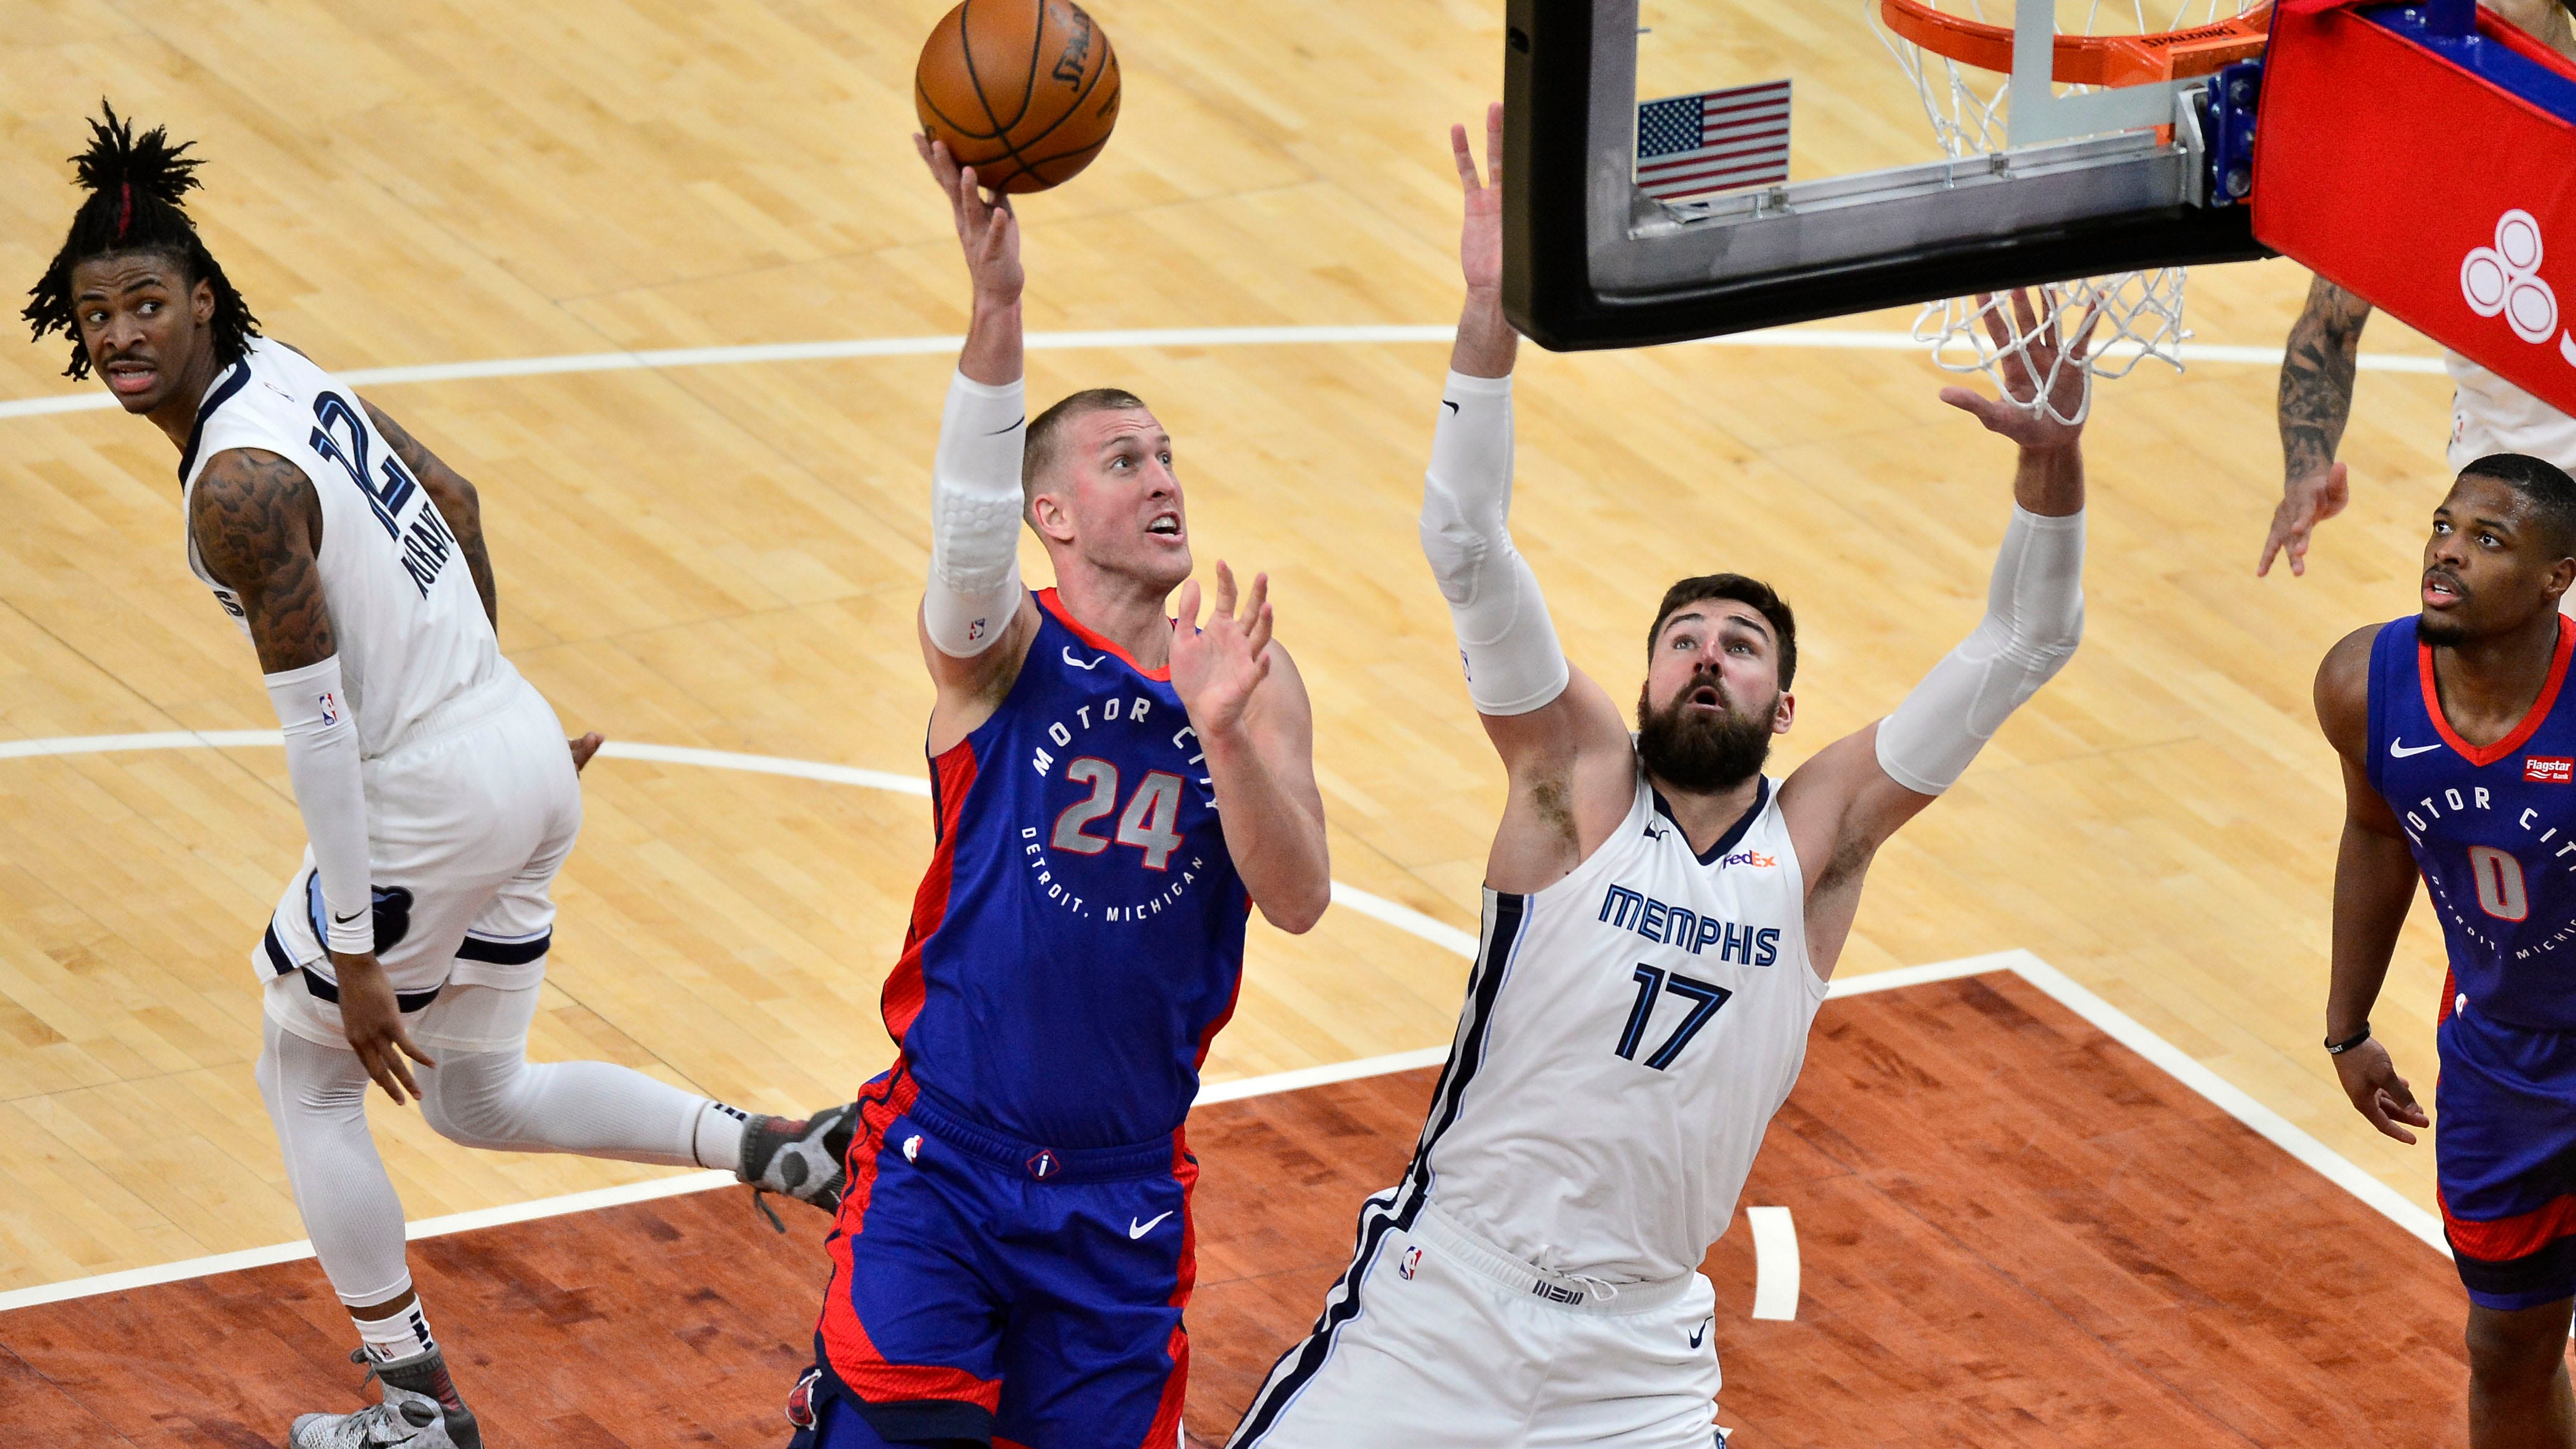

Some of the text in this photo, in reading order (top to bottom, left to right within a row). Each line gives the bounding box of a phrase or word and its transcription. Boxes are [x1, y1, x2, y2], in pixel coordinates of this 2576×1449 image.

[310, 391, 416, 543] 12
[1032, 697, 1151, 777] MOTOR
[2526, 759, 2571, 772] Flagstar
[1050, 756, 1186, 872] 24
[2519, 807, 2576, 872] CIT
[1106, 857, 1203, 922] MICHIGAN
[1723, 850, 1777, 870] FedEx
[1598, 883, 1780, 967] MEMPHIS
[1614, 962, 1732, 1071] 17
